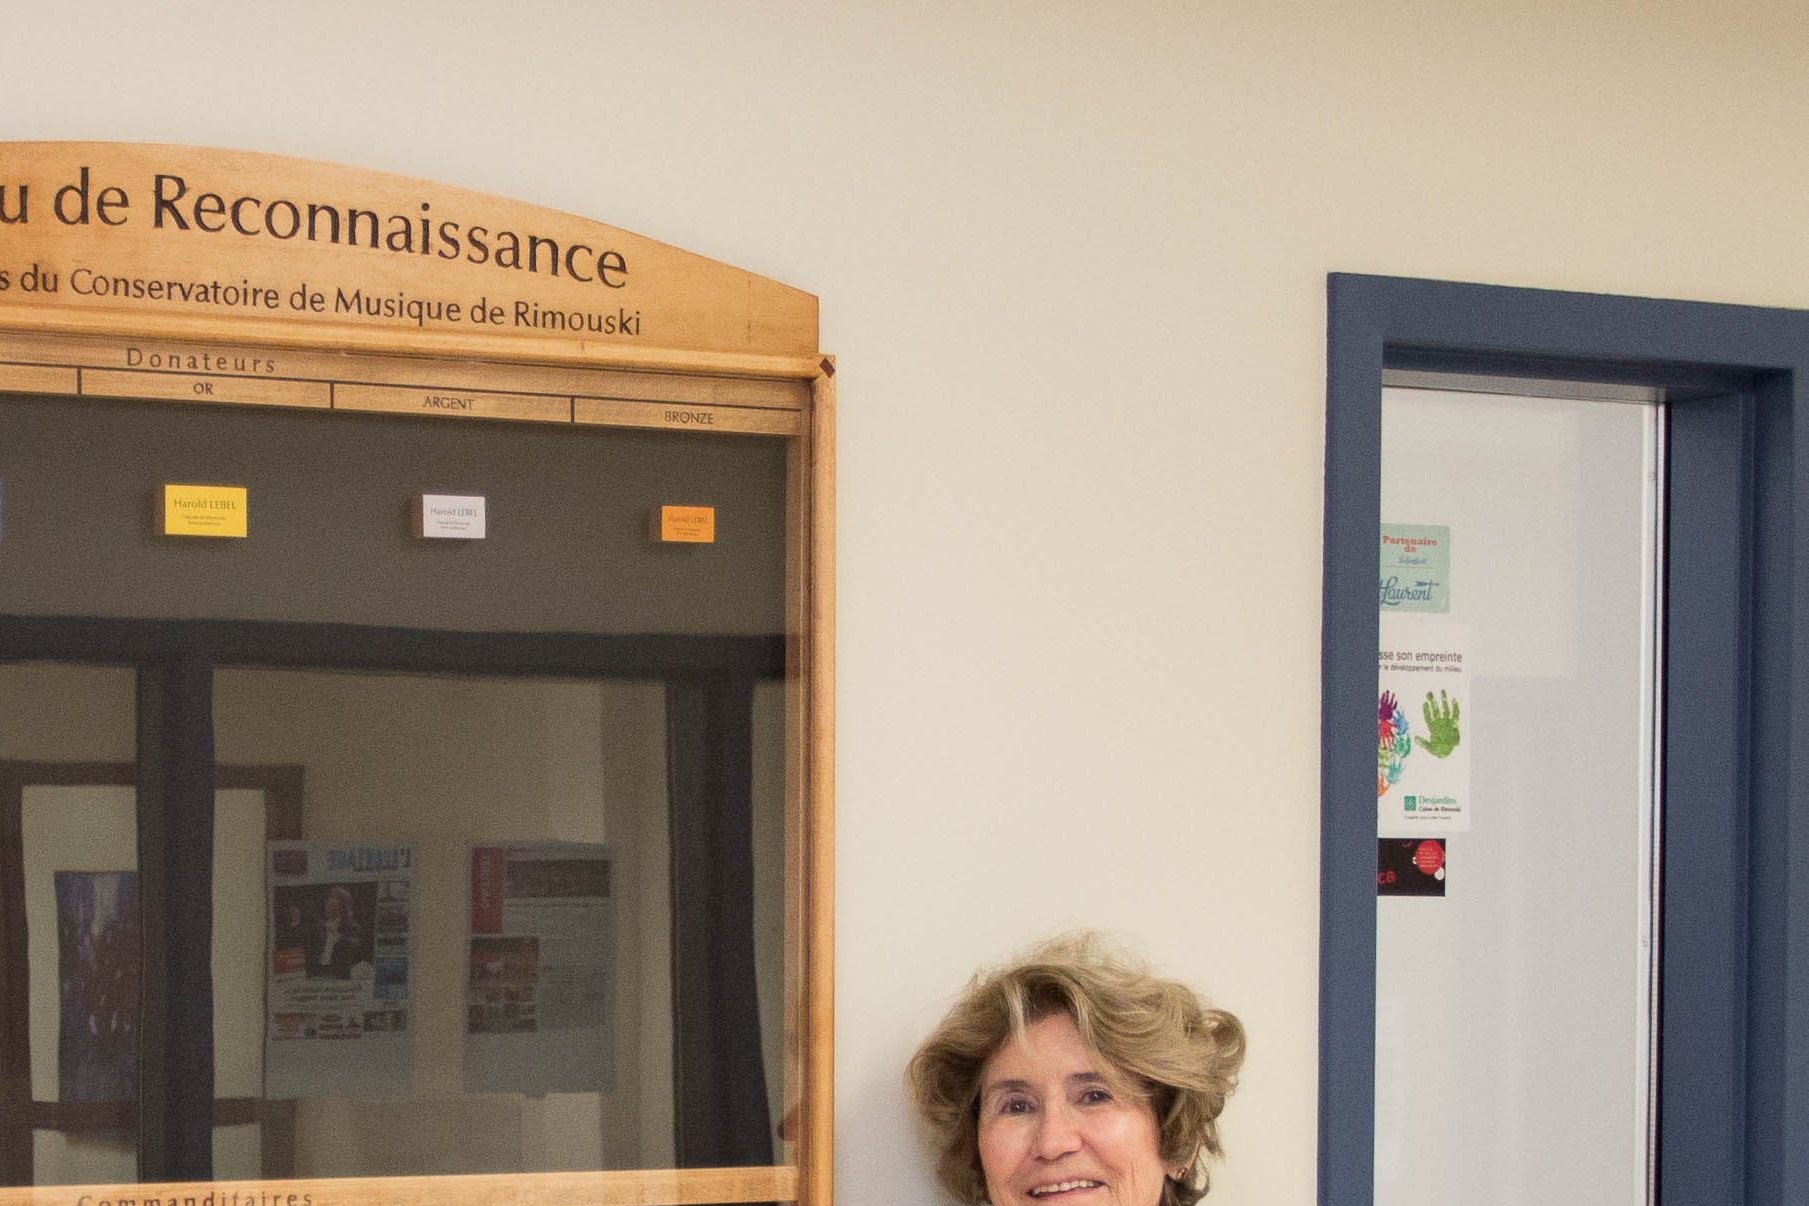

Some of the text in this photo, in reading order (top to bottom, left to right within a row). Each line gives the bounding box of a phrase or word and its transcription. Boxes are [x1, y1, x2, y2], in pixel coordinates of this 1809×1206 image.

[54, 166, 129, 226] de
[153, 173, 628, 289] Reconnaissance
[20, 264, 59, 294] du
[71, 269, 279, 309] Conservatoire
[290, 284, 326, 313] de
[334, 287, 461, 327] Musique
[470, 297, 505, 326] de
[514, 301, 640, 336] Rimouski
[126, 347, 276, 374] Donateurs
[193, 383, 214, 396] OR
[423, 396, 475, 411] ARGENT
[664, 410, 714, 425] BRONZE
[174, 499, 207, 509] Harold
[1382, 535, 1437, 546] Partenaire
[1397, 652, 1412, 661] son
[1415, 651, 1462, 663] empreinte
